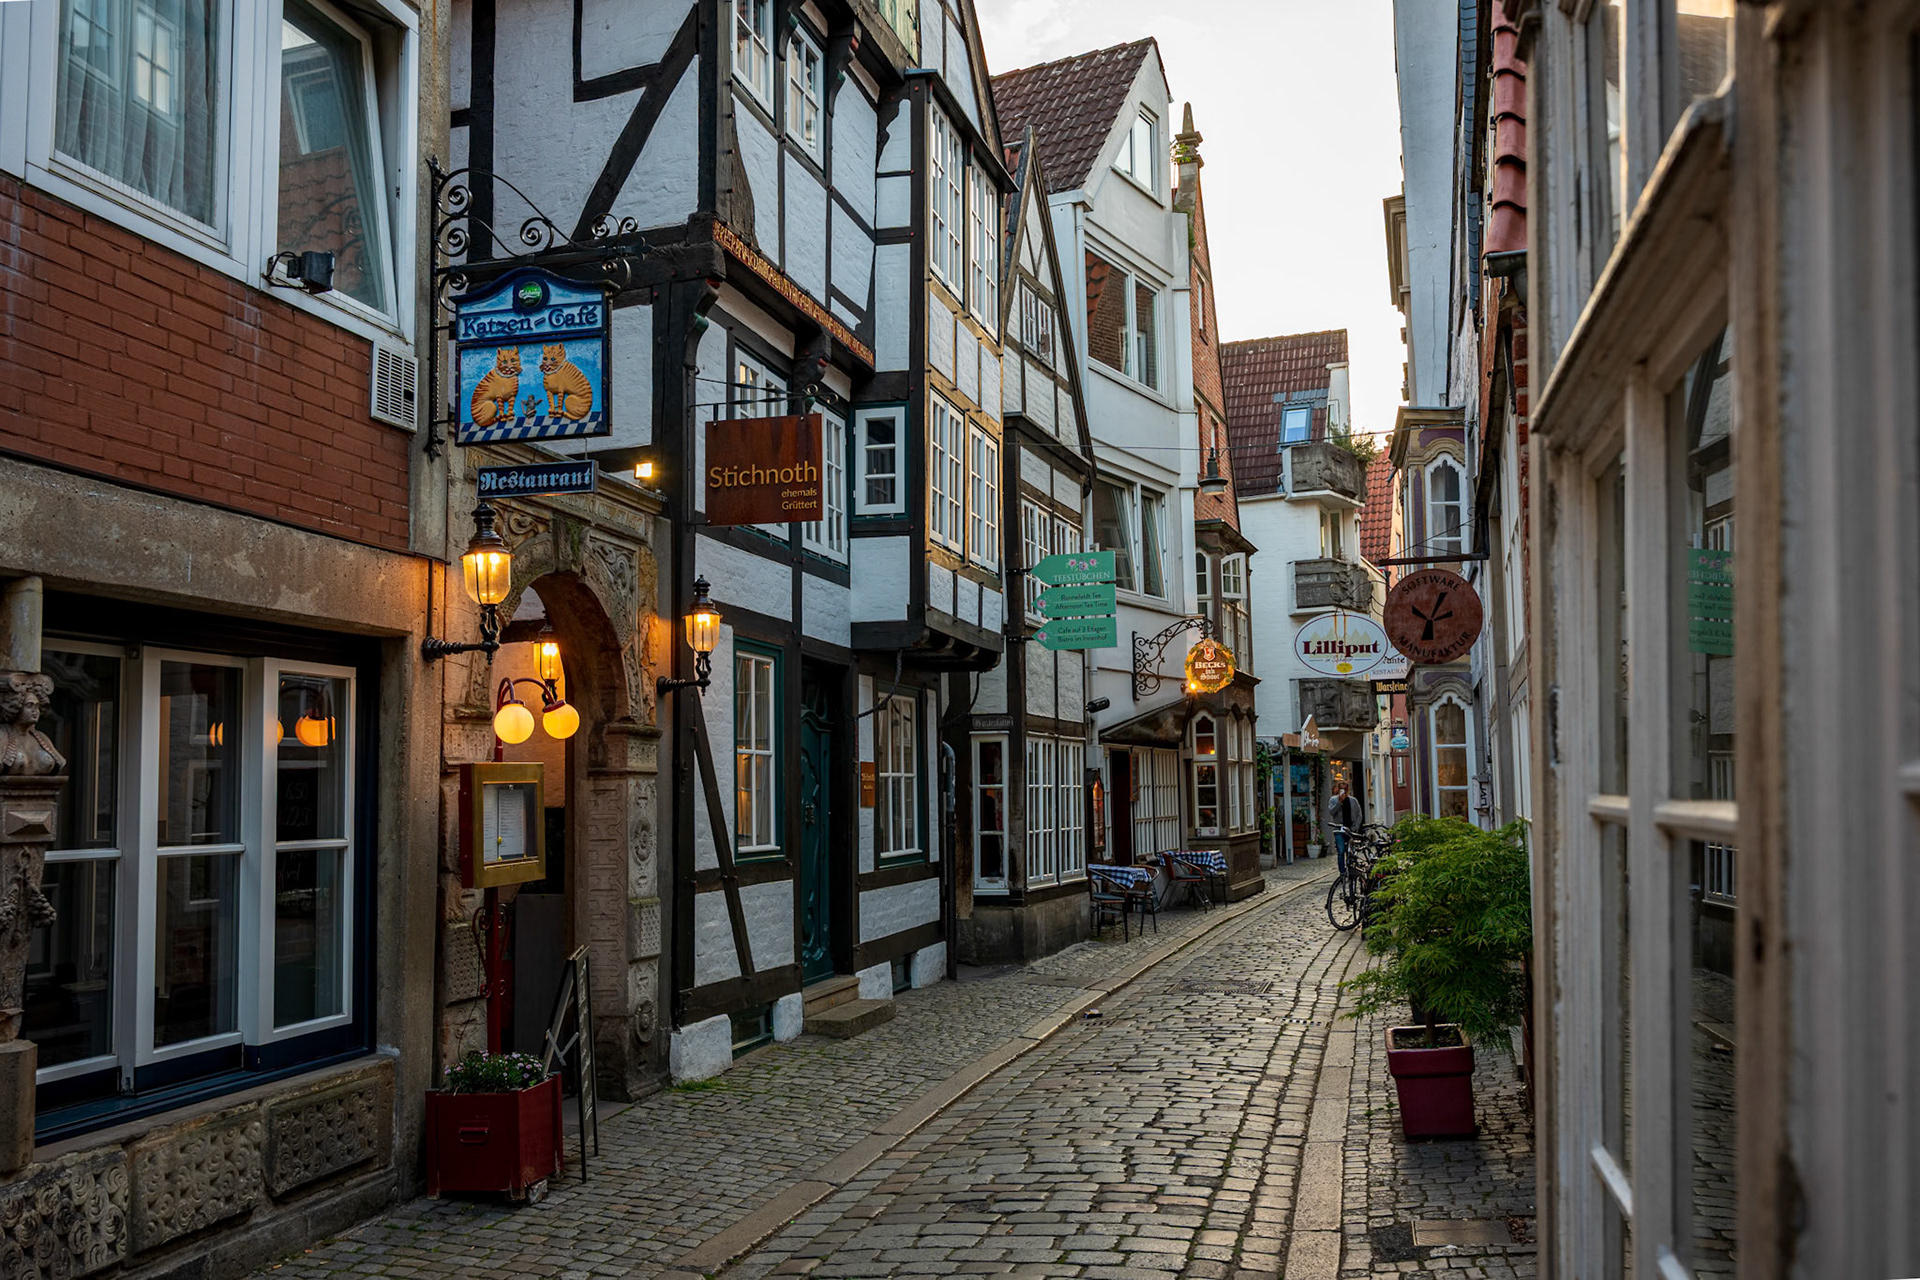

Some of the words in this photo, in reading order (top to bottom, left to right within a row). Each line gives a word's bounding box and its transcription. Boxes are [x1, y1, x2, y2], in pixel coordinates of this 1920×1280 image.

[462, 305, 598, 338] Katzen-Café
[479, 468, 591, 490] Restaurant
[709, 461, 817, 488] Stichnoth
[781, 488, 817, 498] ehemals
[781, 500, 817, 510] Grüttert
[1053, 571, 1110, 582] TEESTÜBCHEN
[1402, 575, 1460, 595] SOFTWARE
[1303, 640, 1381, 658] Lilliput
[1398, 631, 1471, 657] MANUFAKTUR
[1376, 681, 1408, 693] Warsteine
